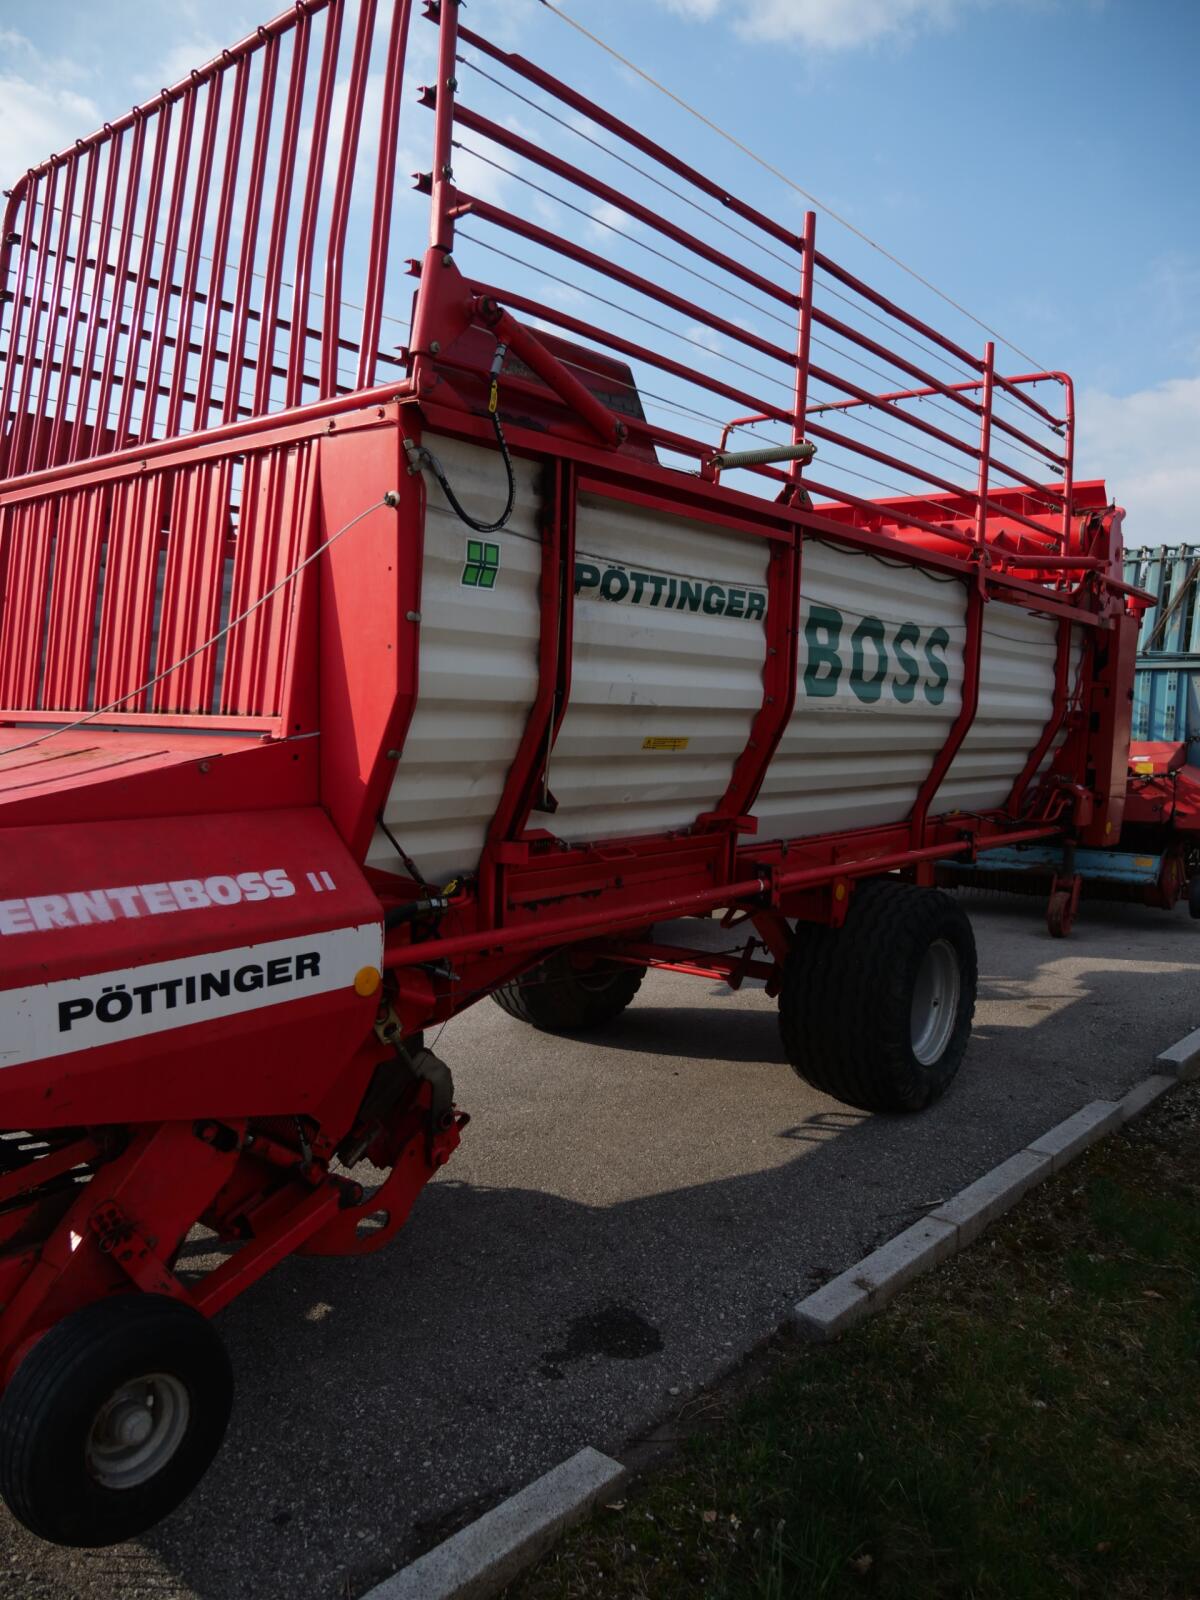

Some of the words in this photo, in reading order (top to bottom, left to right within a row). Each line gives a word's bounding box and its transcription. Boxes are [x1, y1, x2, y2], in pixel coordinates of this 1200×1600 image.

[574, 562, 766, 621] PÖTTINGER
[804, 605, 949, 706] BOSS
[0, 868, 296, 936] ERNTEBOSS
[58, 951, 321, 1032] PÖTTINGER
